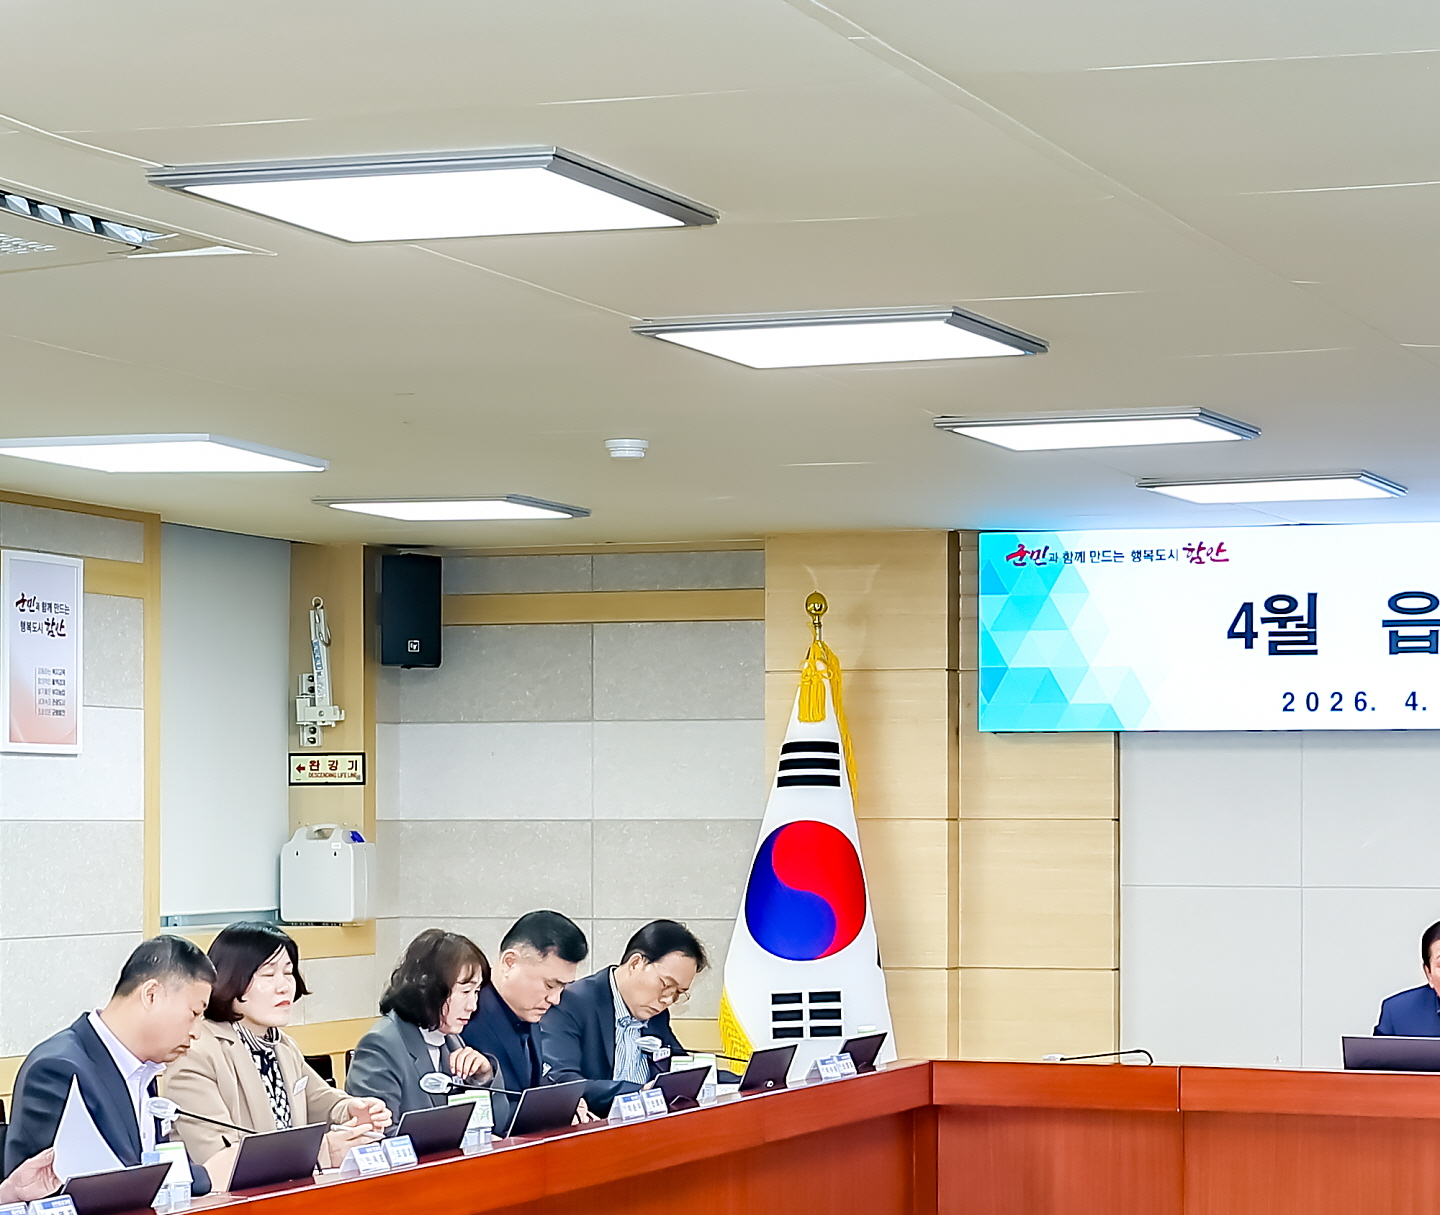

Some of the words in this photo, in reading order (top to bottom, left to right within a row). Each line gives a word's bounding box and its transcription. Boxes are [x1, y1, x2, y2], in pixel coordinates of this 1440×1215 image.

[1005, 543, 1059, 567] 군민과
[1062, 550, 1086, 565] 함께
[1089, 550, 1125, 564] 만드는
[1131, 549, 1179, 563] 행복도시
[1182, 541, 1230, 565] 함안
[42, 601, 53, 614] 함께
[54, 603, 70, 616] 만드는
[20, 620, 44, 634] 행복도시
[44, 617, 66, 638] 함안
[1227, 592, 1318, 656] 4월
[1281, 691, 1377, 712] 2026.
[1404, 691, 1427, 712] 4.
[308, 759, 358, 772] 완강기
